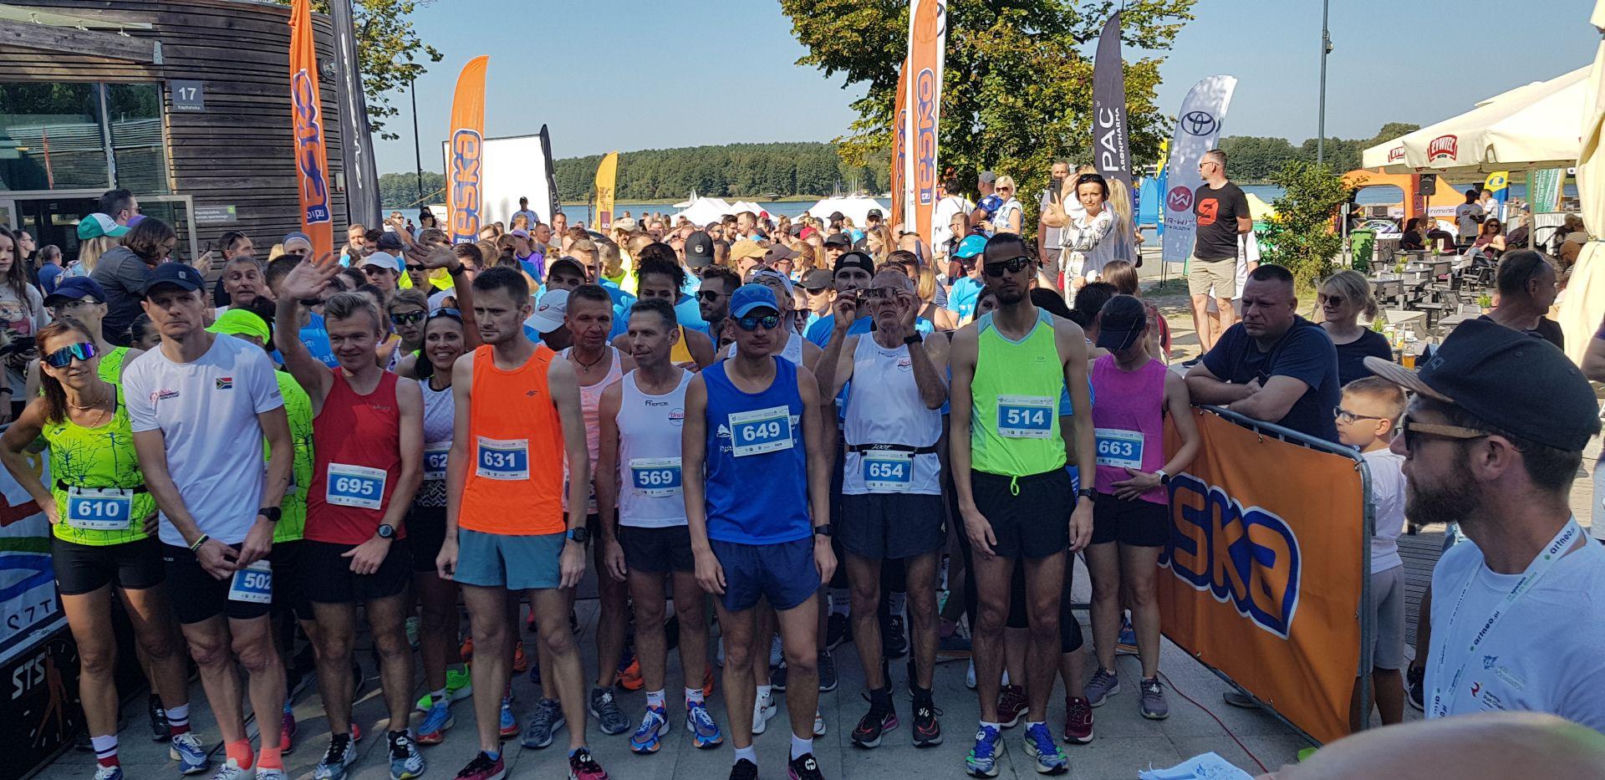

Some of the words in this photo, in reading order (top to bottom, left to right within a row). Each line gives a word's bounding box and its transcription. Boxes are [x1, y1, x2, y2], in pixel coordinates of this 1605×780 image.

[178, 87, 197, 100] 17
[1007, 409, 1044, 425] 514
[742, 421, 780, 441] 649
[1098, 440, 1132, 456] 663
[429, 454, 448, 468] 62
[484, 451, 516, 468] 631
[640, 470, 673, 485] 569
[869, 463, 903, 478] 654
[336, 477, 374, 495] 695
[78, 501, 119, 517] 610
[1168, 476, 1298, 632] ska
[244, 572, 271, 590] 502
[12, 652, 46, 699] STS
